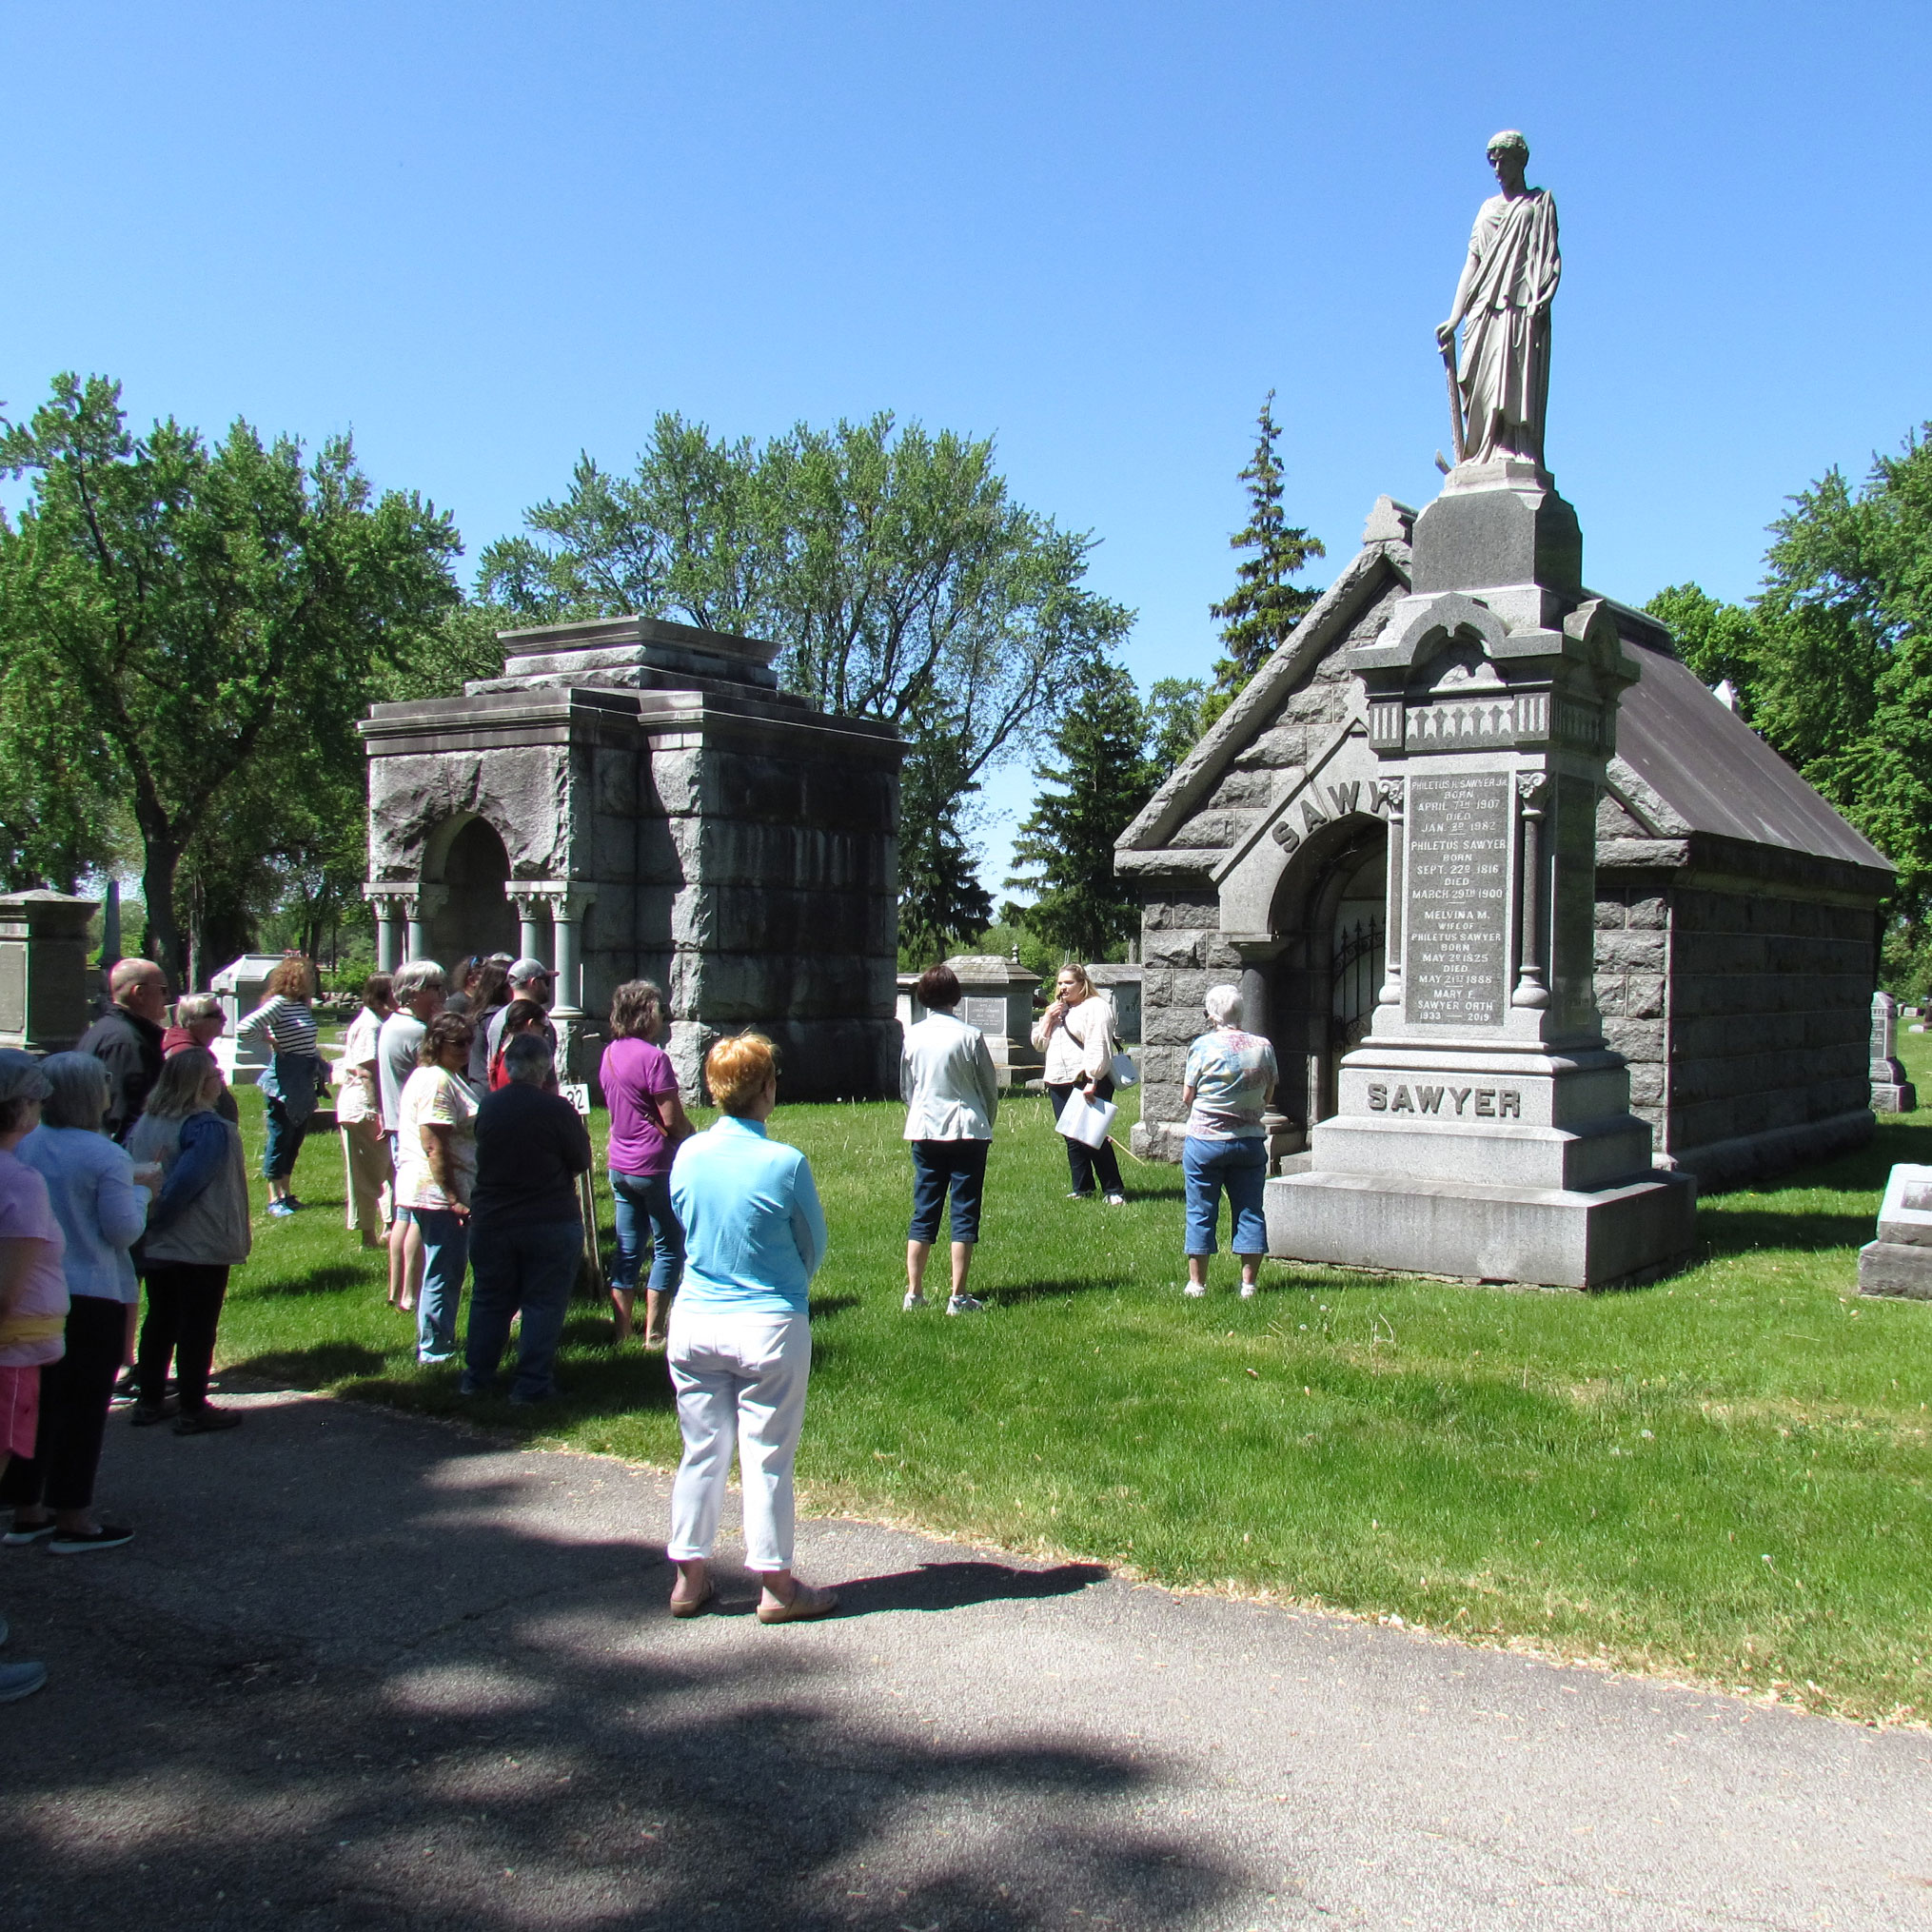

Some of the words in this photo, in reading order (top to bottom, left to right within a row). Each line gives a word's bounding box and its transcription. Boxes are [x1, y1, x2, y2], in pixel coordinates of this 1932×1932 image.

[1411, 780, 1449, 791] PHILETUS
[1460, 778, 1495, 788] SAWYER
[1443, 789, 1474, 799] BORN
[1417, 802, 1448, 812] APRIL
[1452, 800, 1470, 811] 7TH
[1476, 799, 1501, 810] 1907
[1446, 812, 1471, 821] DIED
[1470, 821, 1496, 831] 1982
[1410, 840, 1459, 851] PHILETUS
[1463, 839, 1506, 850] SAWYER
[1416, 865, 1448, 876] SEPT.
[1476, 864, 1499, 874] 1816
[1444, 877, 1469, 886] DIED
[1412, 890, 1449, 899] MARCH
[1451, 889, 1475, 899] 29TH
[1478, 889, 1503, 898] 1900
[1424, 911, 1474, 919] MELVINA
[1476, 911, 1490, 919] M.
[1459, 933, 1501, 941] SAWYER
[1440, 943, 1470, 952] BORN
[1422, 954, 1446, 962] MAY
[1463, 954, 1488, 963] 1825
[1443, 964, 1469, 973] DIED
[1418, 975, 1442, 983] MAY
[1466, 976, 1492, 984] 1888
[1433, 990, 1463, 999] MARY
[1417, 1000, 1460, 1010] SAWYER
[1465, 1002, 1493, 1011] ORTH
[1420, 1012, 1442, 1020] 1933
[566, 1090, 584, 1110] 32
[1368, 1083, 1520, 1117] SAWYER
